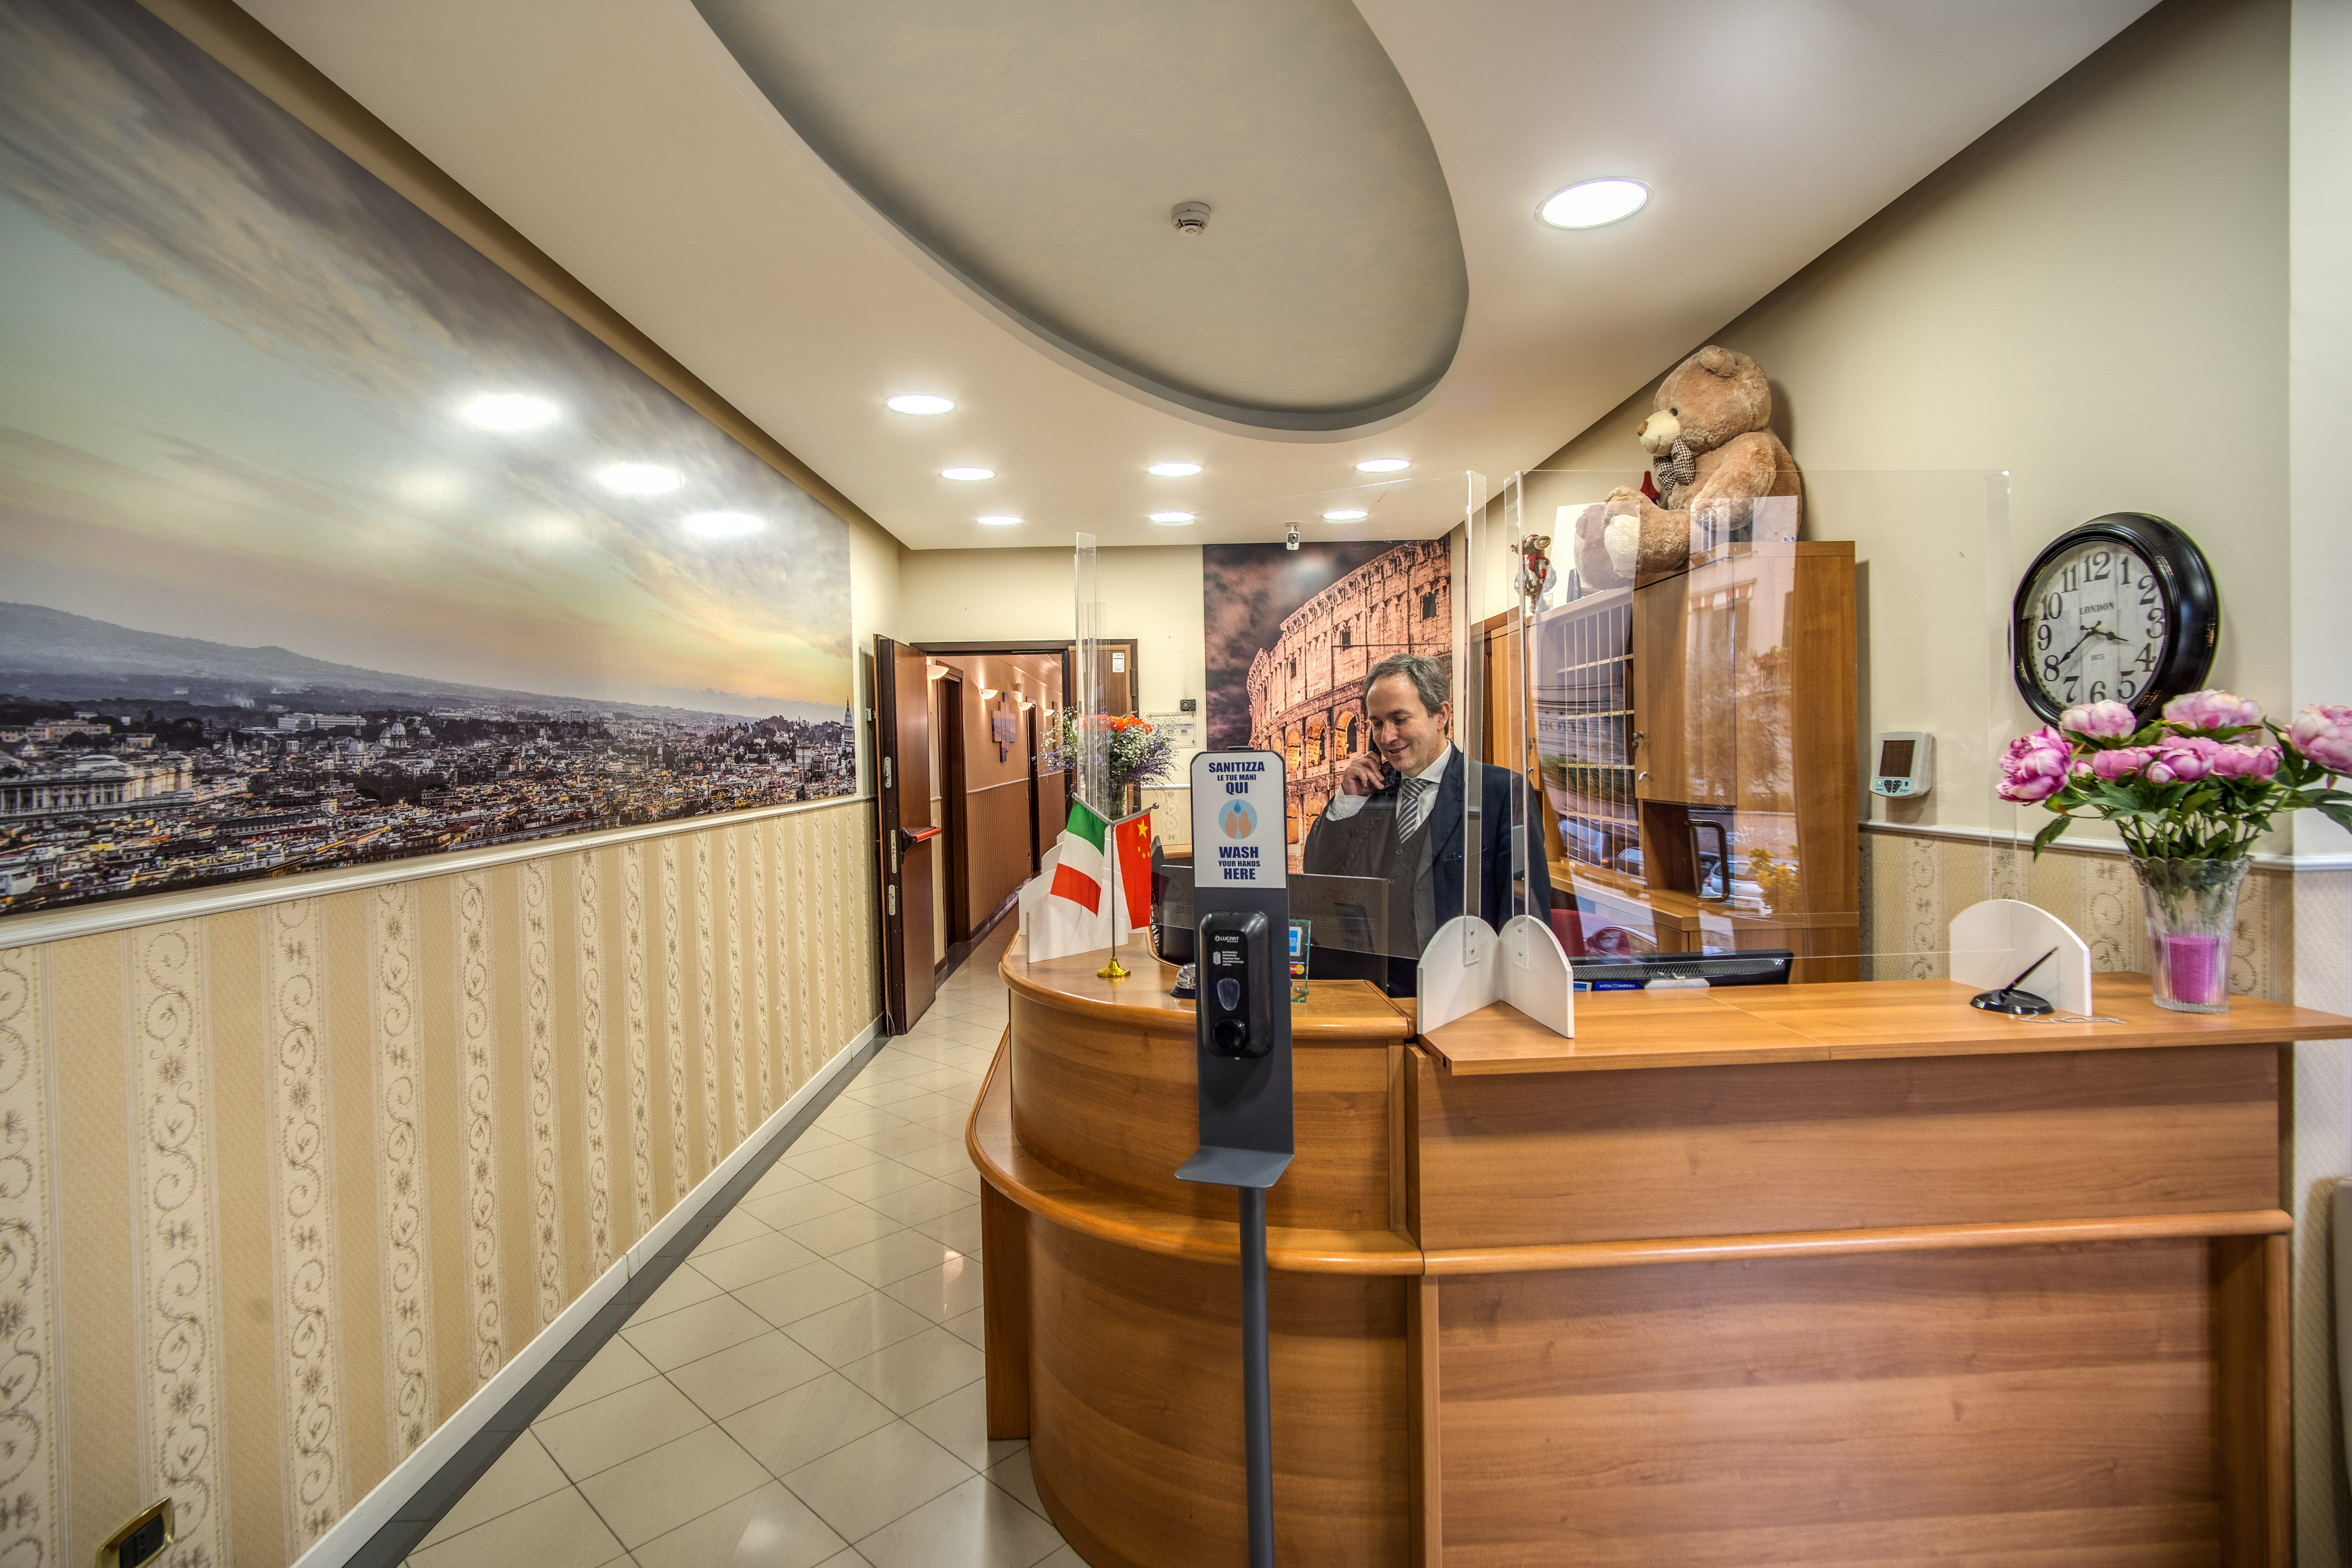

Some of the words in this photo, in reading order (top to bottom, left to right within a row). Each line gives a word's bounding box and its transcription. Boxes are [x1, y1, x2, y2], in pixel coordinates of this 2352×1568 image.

[2061, 564, 2080, 593] 11
[2083, 551, 2112, 583] 12
[2120, 556, 2132, 585] 1
[2138, 575, 2158, 605] 2
[2040, 592, 2063, 620] 10
[2079, 602, 2115, 615] LONDON
[2038, 624, 2053, 650] 9
[2147, 607, 2165, 639] 3
[2044, 654, 2060, 682] 8
[2134, 642, 2158, 672] 4
[2063, 676, 2080, 704] 7
[2090, 681, 2107, 704] 6
[2118, 670, 2137, 699] 5
[1209, 761, 1265, 773] SANITIZZA
[1226, 782, 1249, 795] QUI
[1219, 847, 1259, 858] WASH
[1224, 868, 1256, 880] HERE
